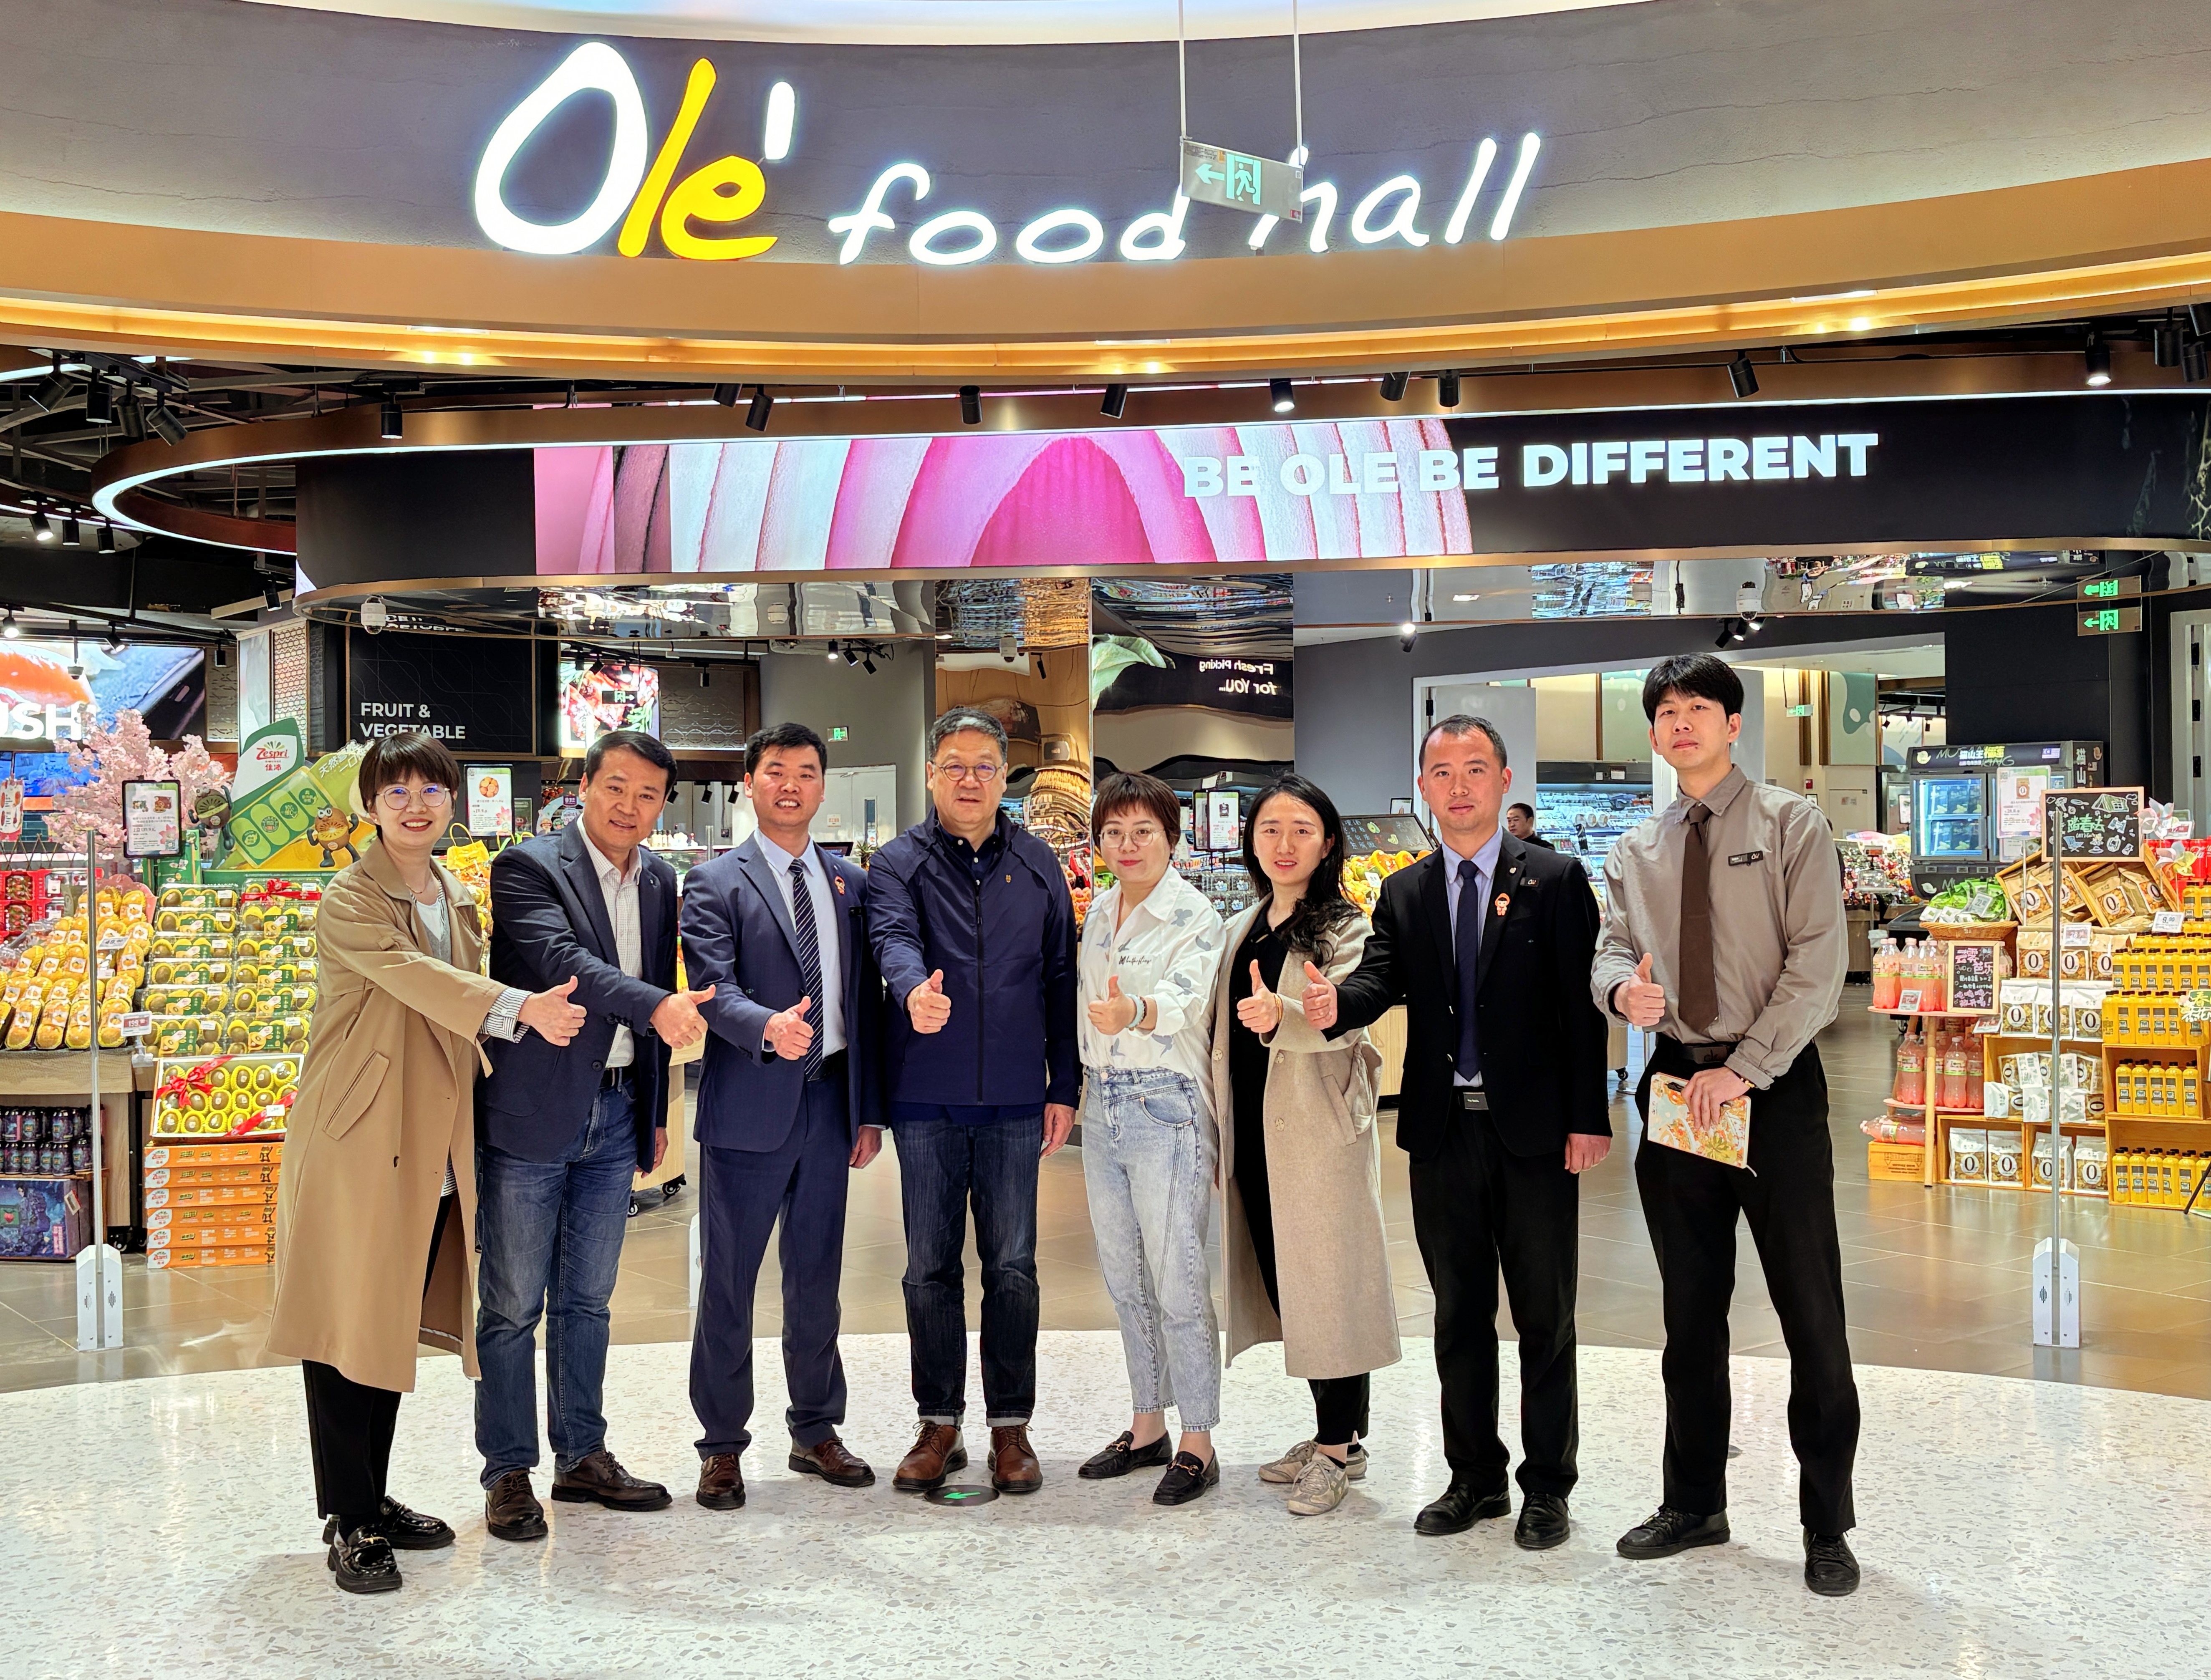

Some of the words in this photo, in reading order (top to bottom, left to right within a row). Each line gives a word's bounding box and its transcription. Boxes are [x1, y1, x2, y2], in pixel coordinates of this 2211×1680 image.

[830, 161, 1190, 265] food
[1184, 455, 1260, 497] BE
[1280, 453, 1399, 496] OLE
[1418, 447, 1500, 491] BE
[1524, 433, 1878, 487] DIFFERENT
[361, 702, 414, 717] FRUIT
[419, 704, 430, 718] &
[256, 748, 288, 760] Zespri
[2067, 813, 2105, 833] 踏春去
